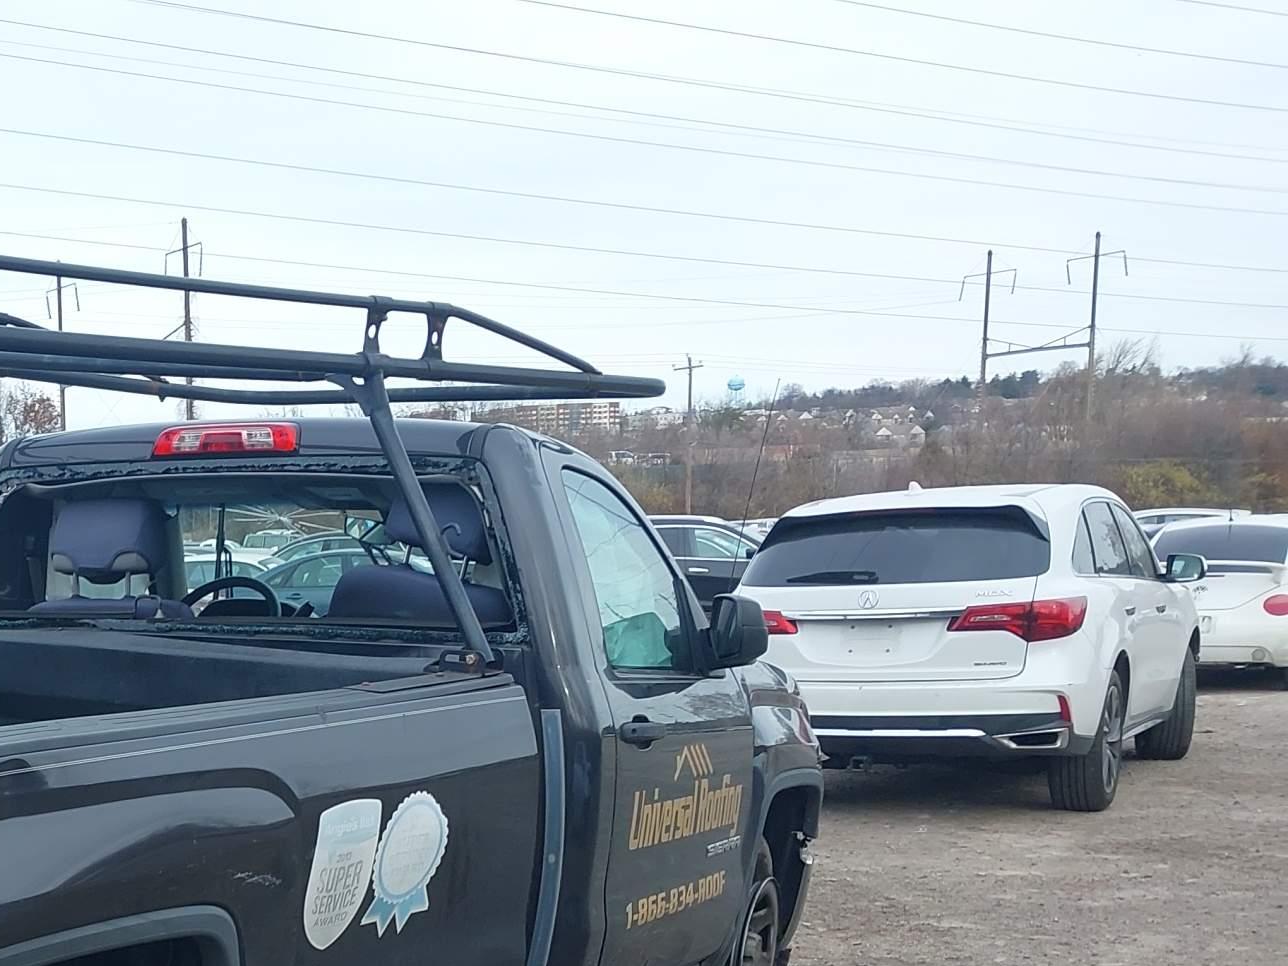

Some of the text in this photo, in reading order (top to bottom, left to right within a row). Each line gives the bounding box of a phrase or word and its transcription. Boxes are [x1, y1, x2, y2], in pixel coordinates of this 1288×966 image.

[629, 773, 743, 850] Universal Roofing
[706, 835, 741, 857] SIERRA
[316, 860, 364, 894] SUPER
[312, 886, 359, 915] SERVICE
[626, 870, 727, 930] 1-866-834-ROOF
[313, 911, 348, 928] AWARD
